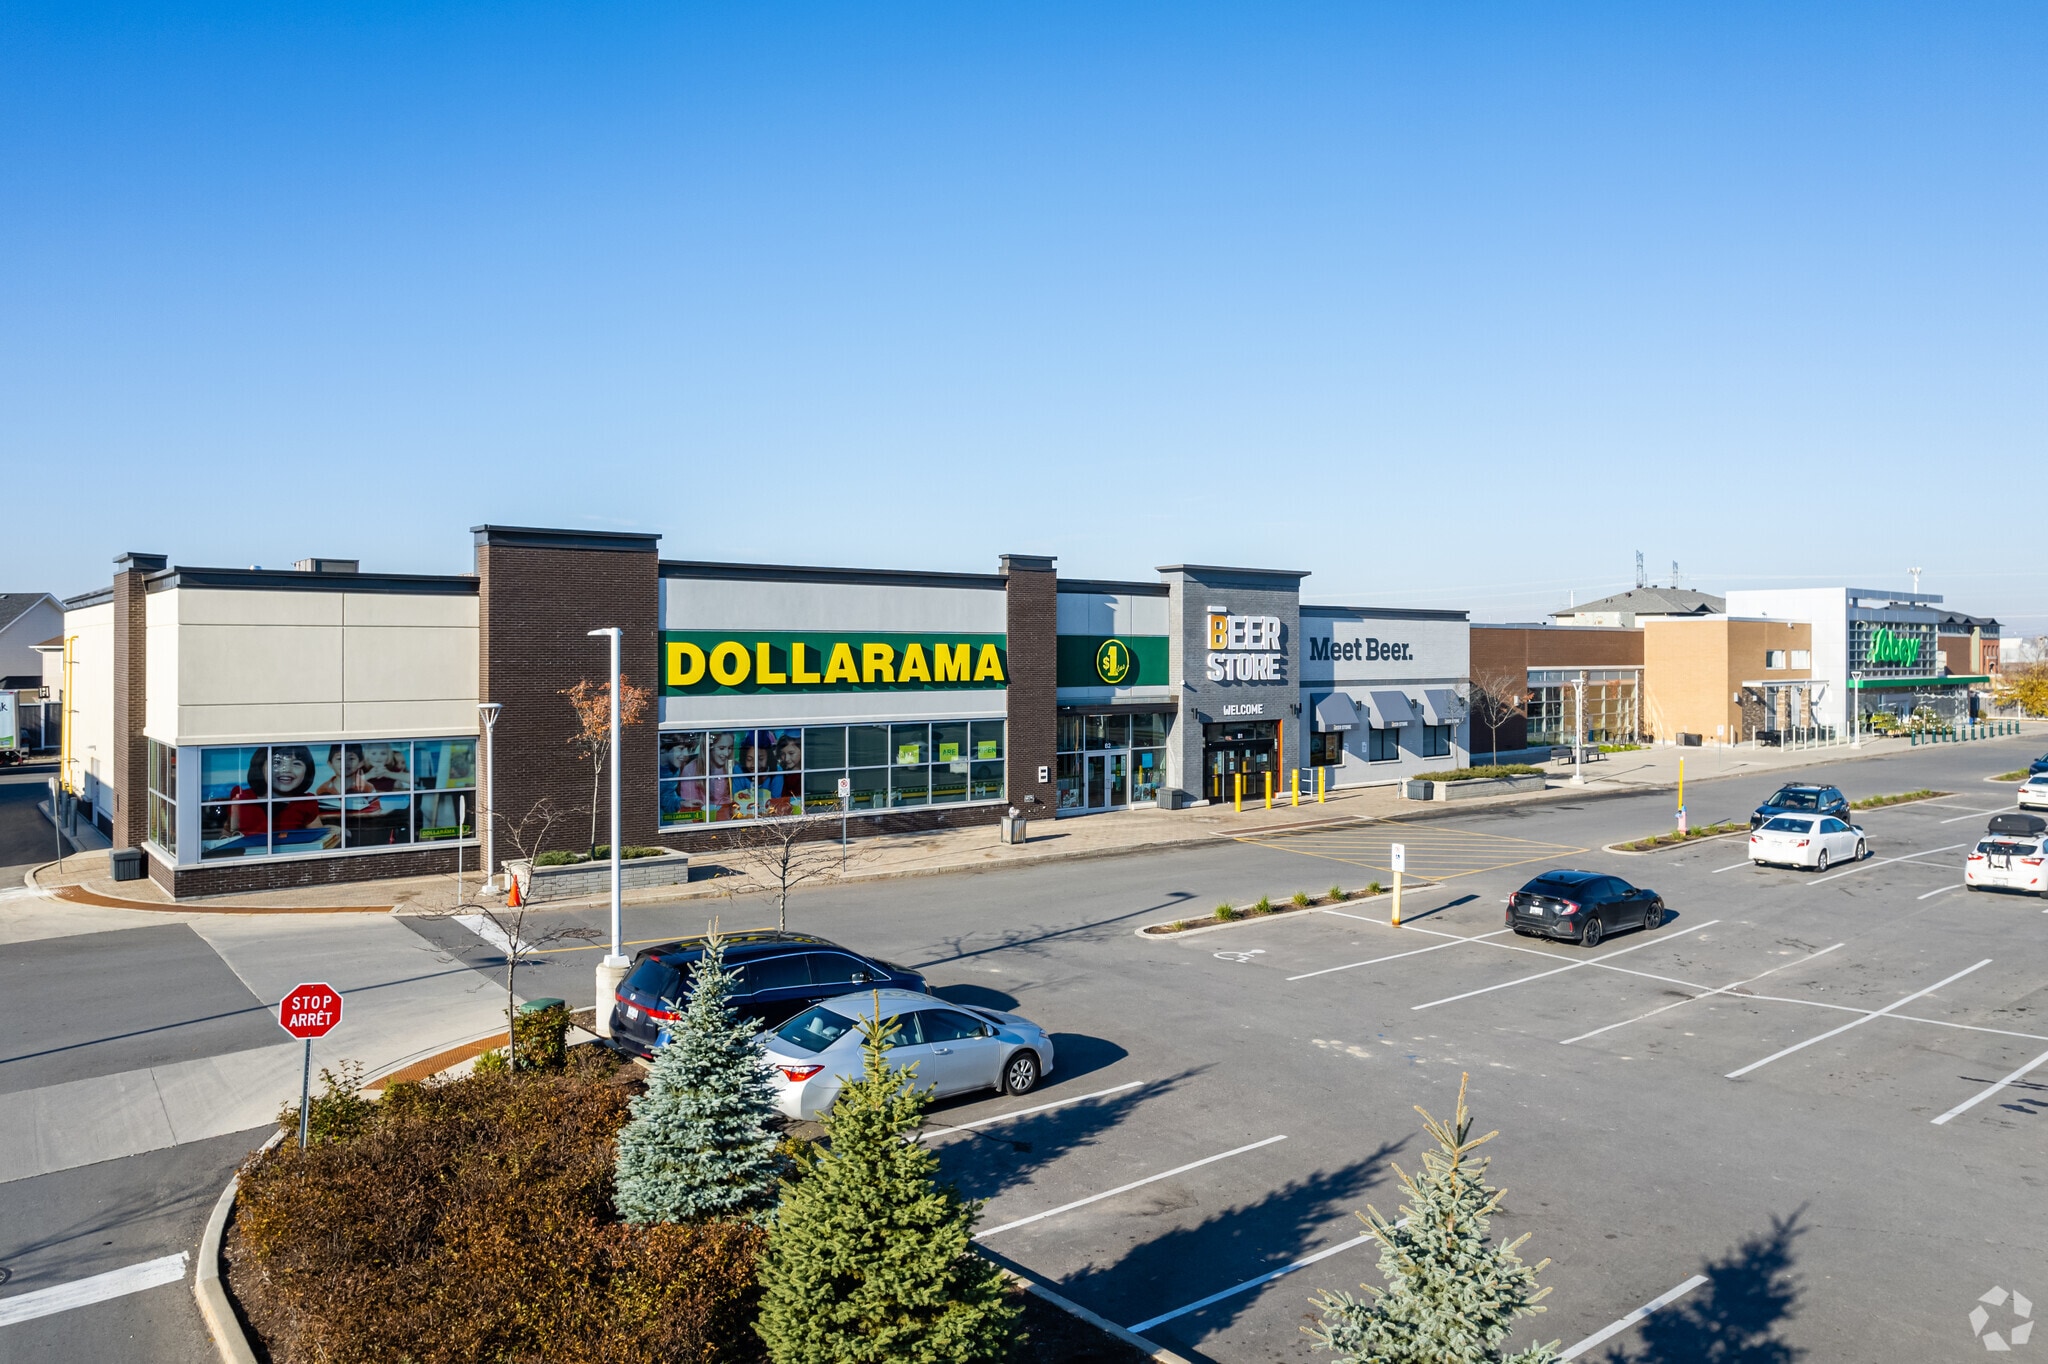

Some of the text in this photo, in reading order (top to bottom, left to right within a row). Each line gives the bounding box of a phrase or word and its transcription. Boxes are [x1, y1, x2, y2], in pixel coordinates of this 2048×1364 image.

[1207, 614, 1281, 650] BEER
[1309, 636, 1414, 661] Meet Beer.
[666, 640, 1005, 686] DOLLARAMA
[1206, 652, 1281, 682] STORE
[1223, 703, 1264, 716] WELCOME
[942, 748, 956, 756] ARE
[291, 995, 332, 1010] STOP
[288, 1010, 333, 1027] ARRÊT
